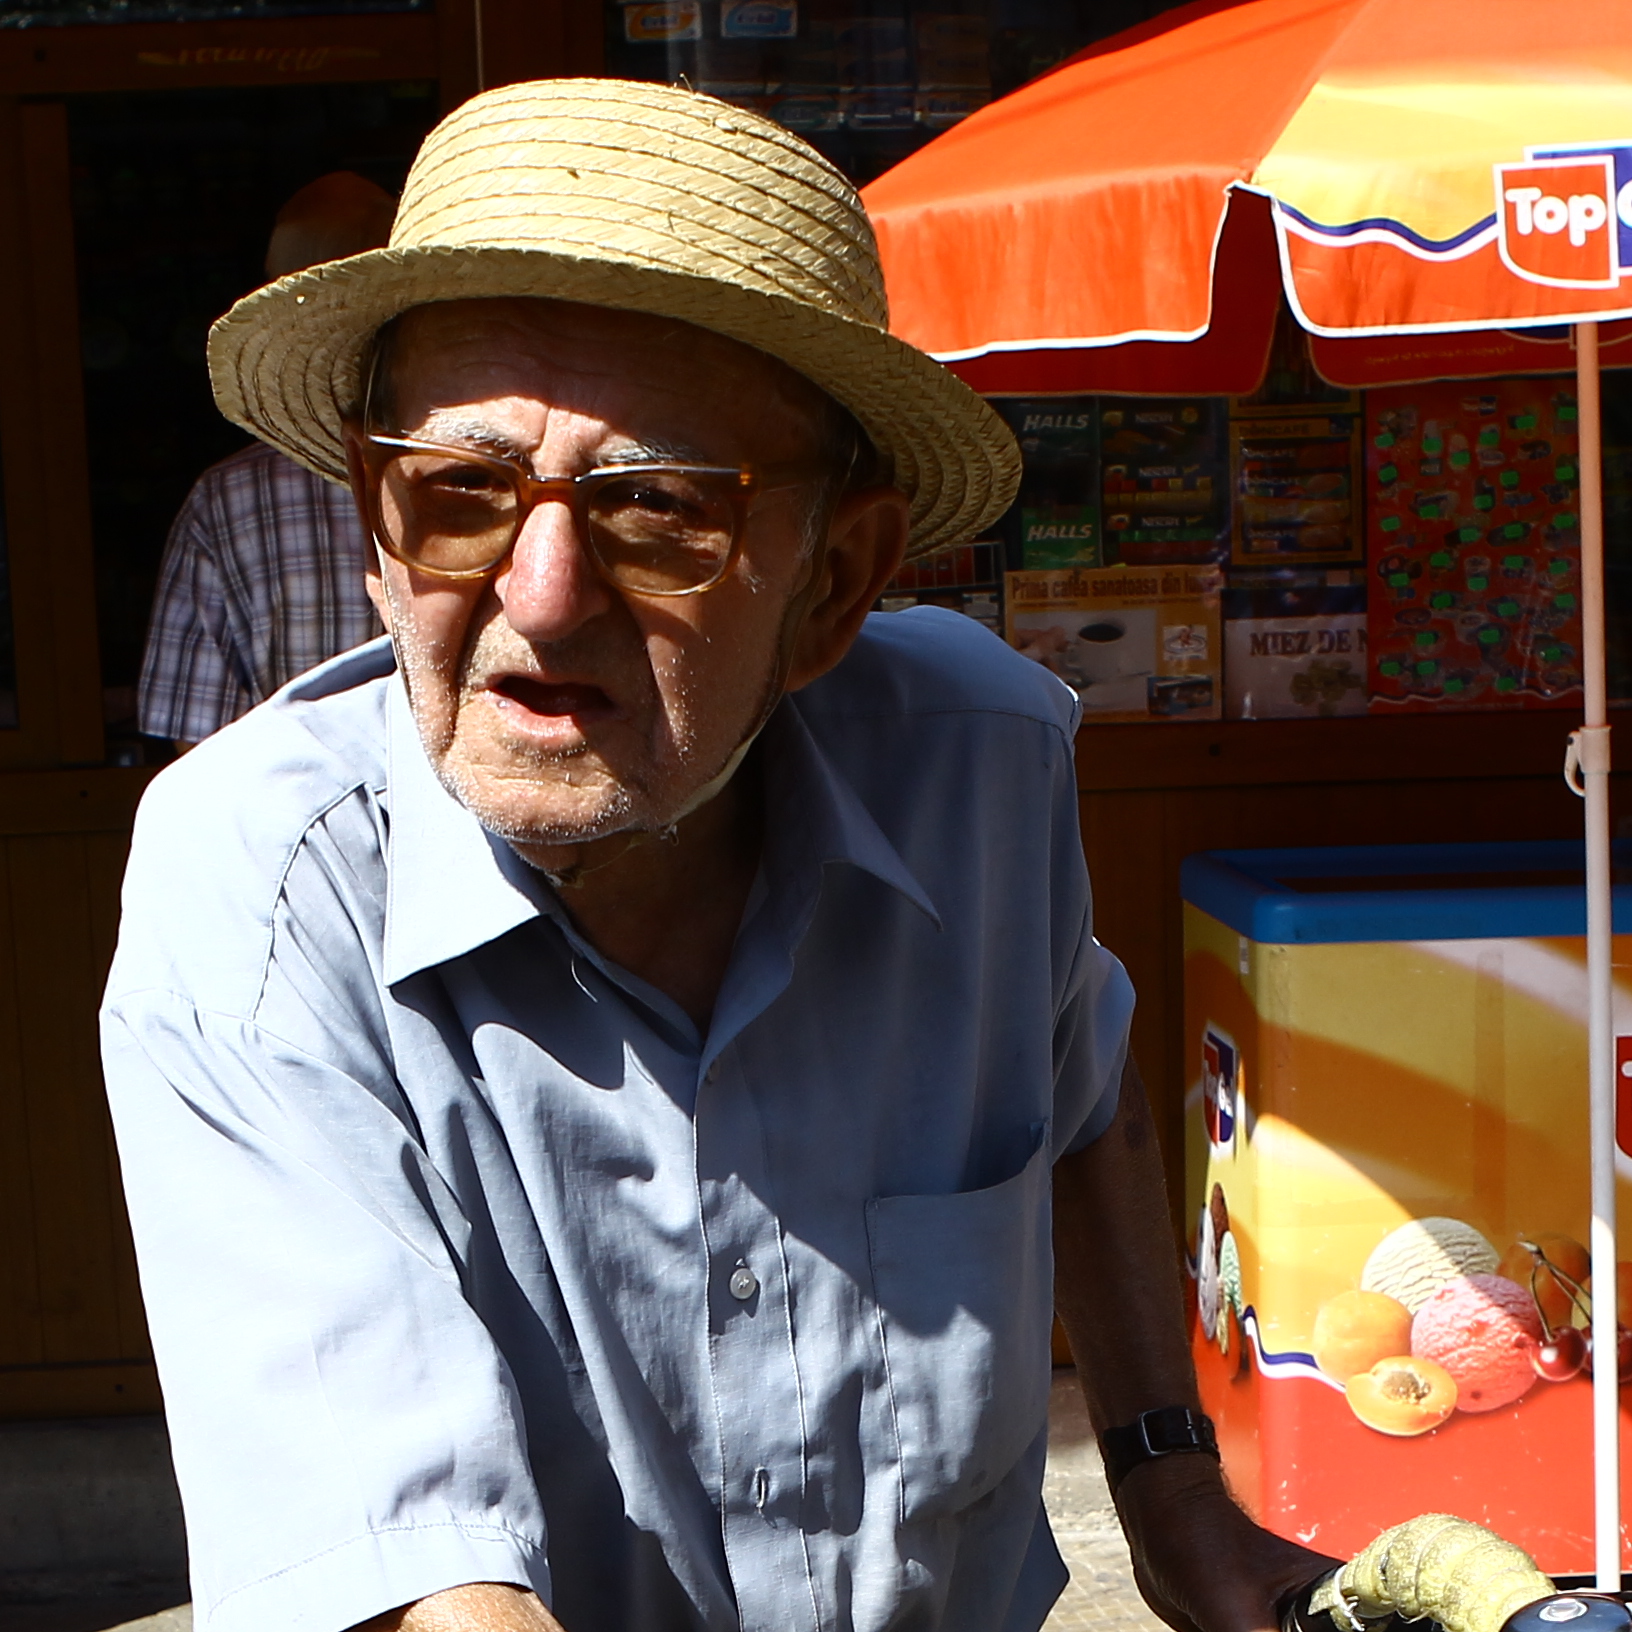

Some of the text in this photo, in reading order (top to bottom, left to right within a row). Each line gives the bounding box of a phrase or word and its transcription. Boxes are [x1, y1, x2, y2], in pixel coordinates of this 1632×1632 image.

[1023, 414, 1089, 431] HALLS
[1027, 524, 1093, 541] HALLS
[1249, 630, 1312, 656] MIEZ
[1317, 628, 1352, 654] DE
